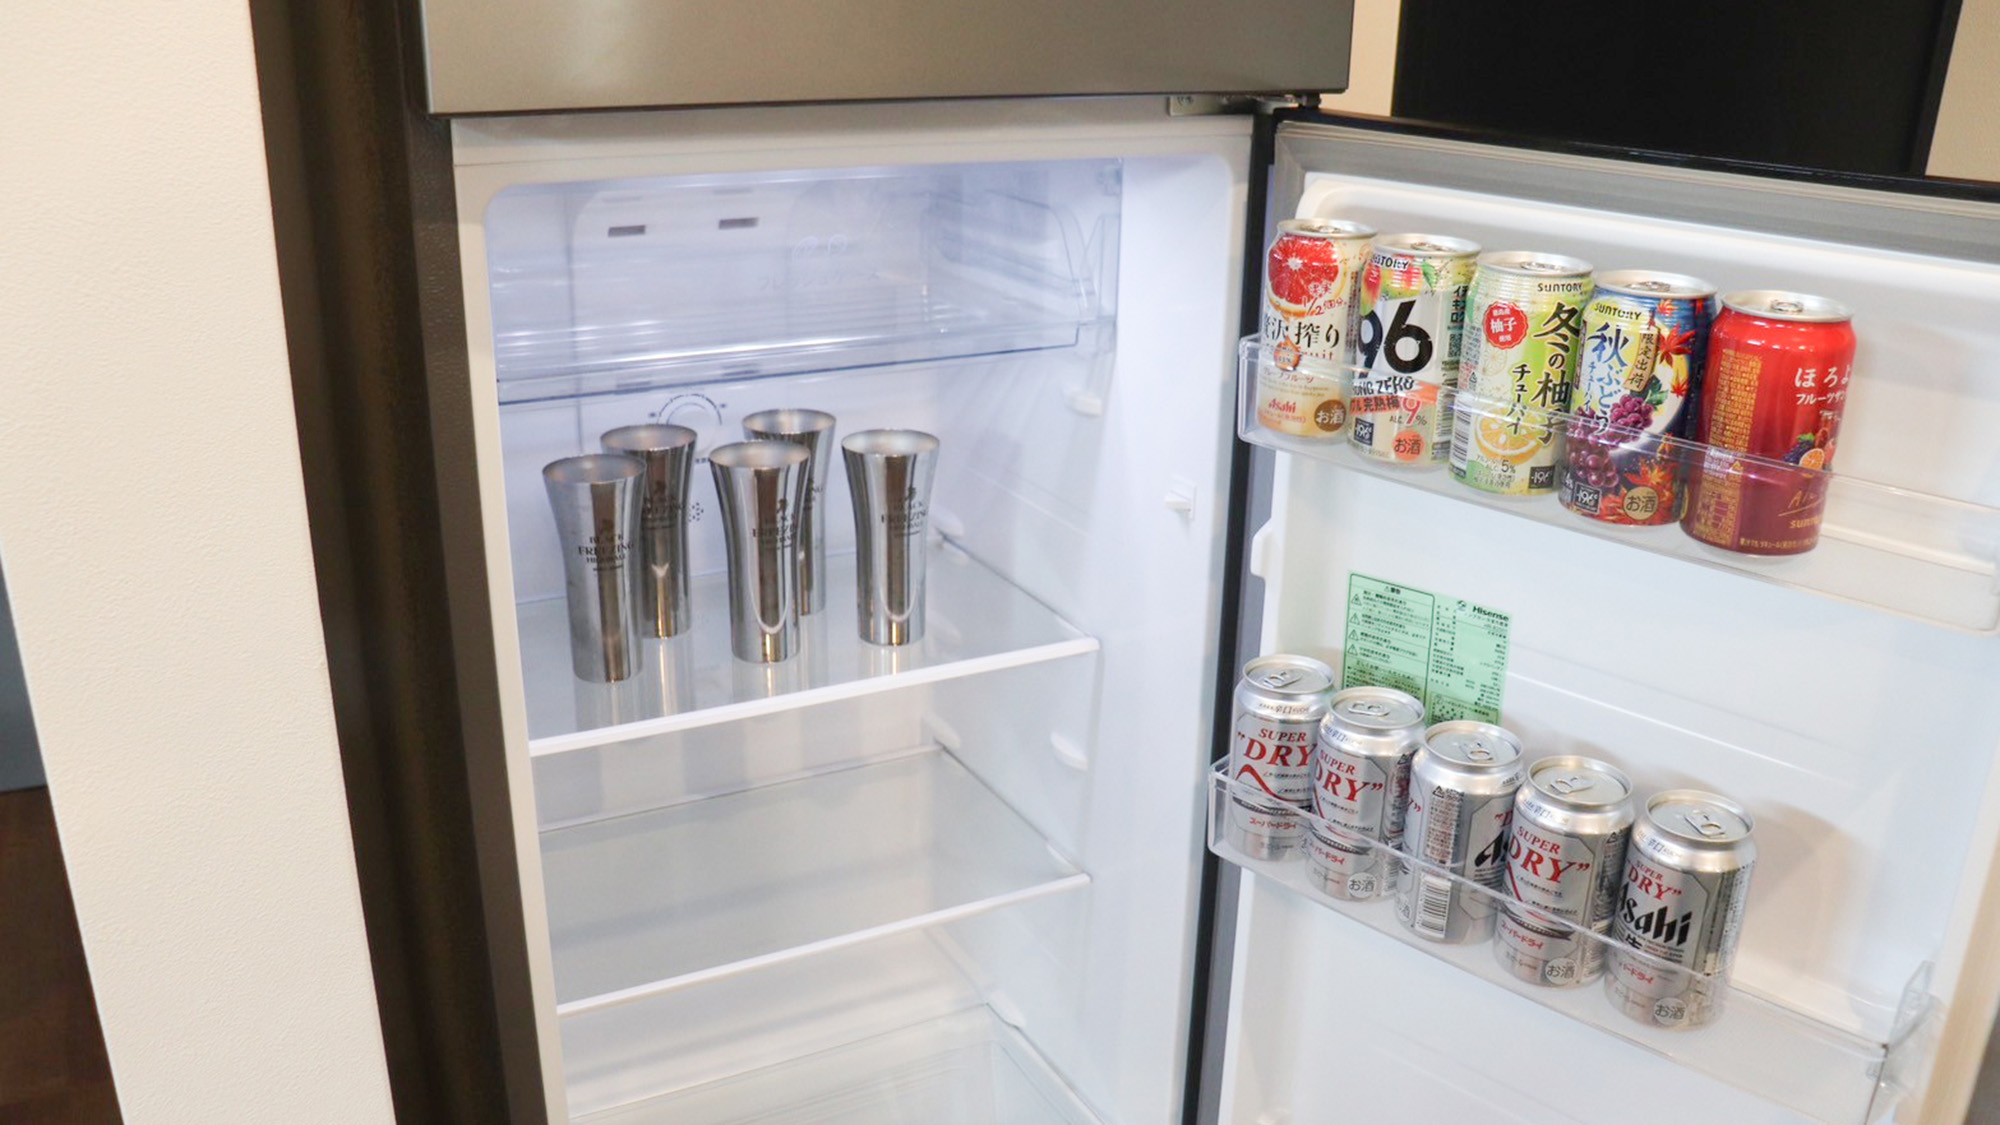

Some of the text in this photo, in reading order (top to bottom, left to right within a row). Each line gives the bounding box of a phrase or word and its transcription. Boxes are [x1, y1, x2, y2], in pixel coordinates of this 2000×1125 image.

[1537, 282, 1583, 294] SUNTORY
[1594, 302, 1642, 320] SUNTORY
[1490, 317, 1517, 334] 柚子
[1629, 333, 1654, 389] 限定出荷
[1532, 301, 1580, 445] 冬の柚子
[1587, 322, 1628, 435] 秋ぶどう
[1506, 363, 1531, 436] チューハイ
[1315, 404, 1344, 425] お酒
[1394, 437, 1421, 455] お酒
[1626, 495, 1657, 512] お酒
[1472, 605, 1509, 621] Hisense
[1259, 728, 1307, 743] SUPER
[1320, 749, 1356, 776] SUPER
[1517, 825, 1561, 855] SUPER
[1348, 876, 1375, 893] お酒
[1547, 962, 1576, 979] お酒
[1654, 1003, 1686, 1020] お酒
